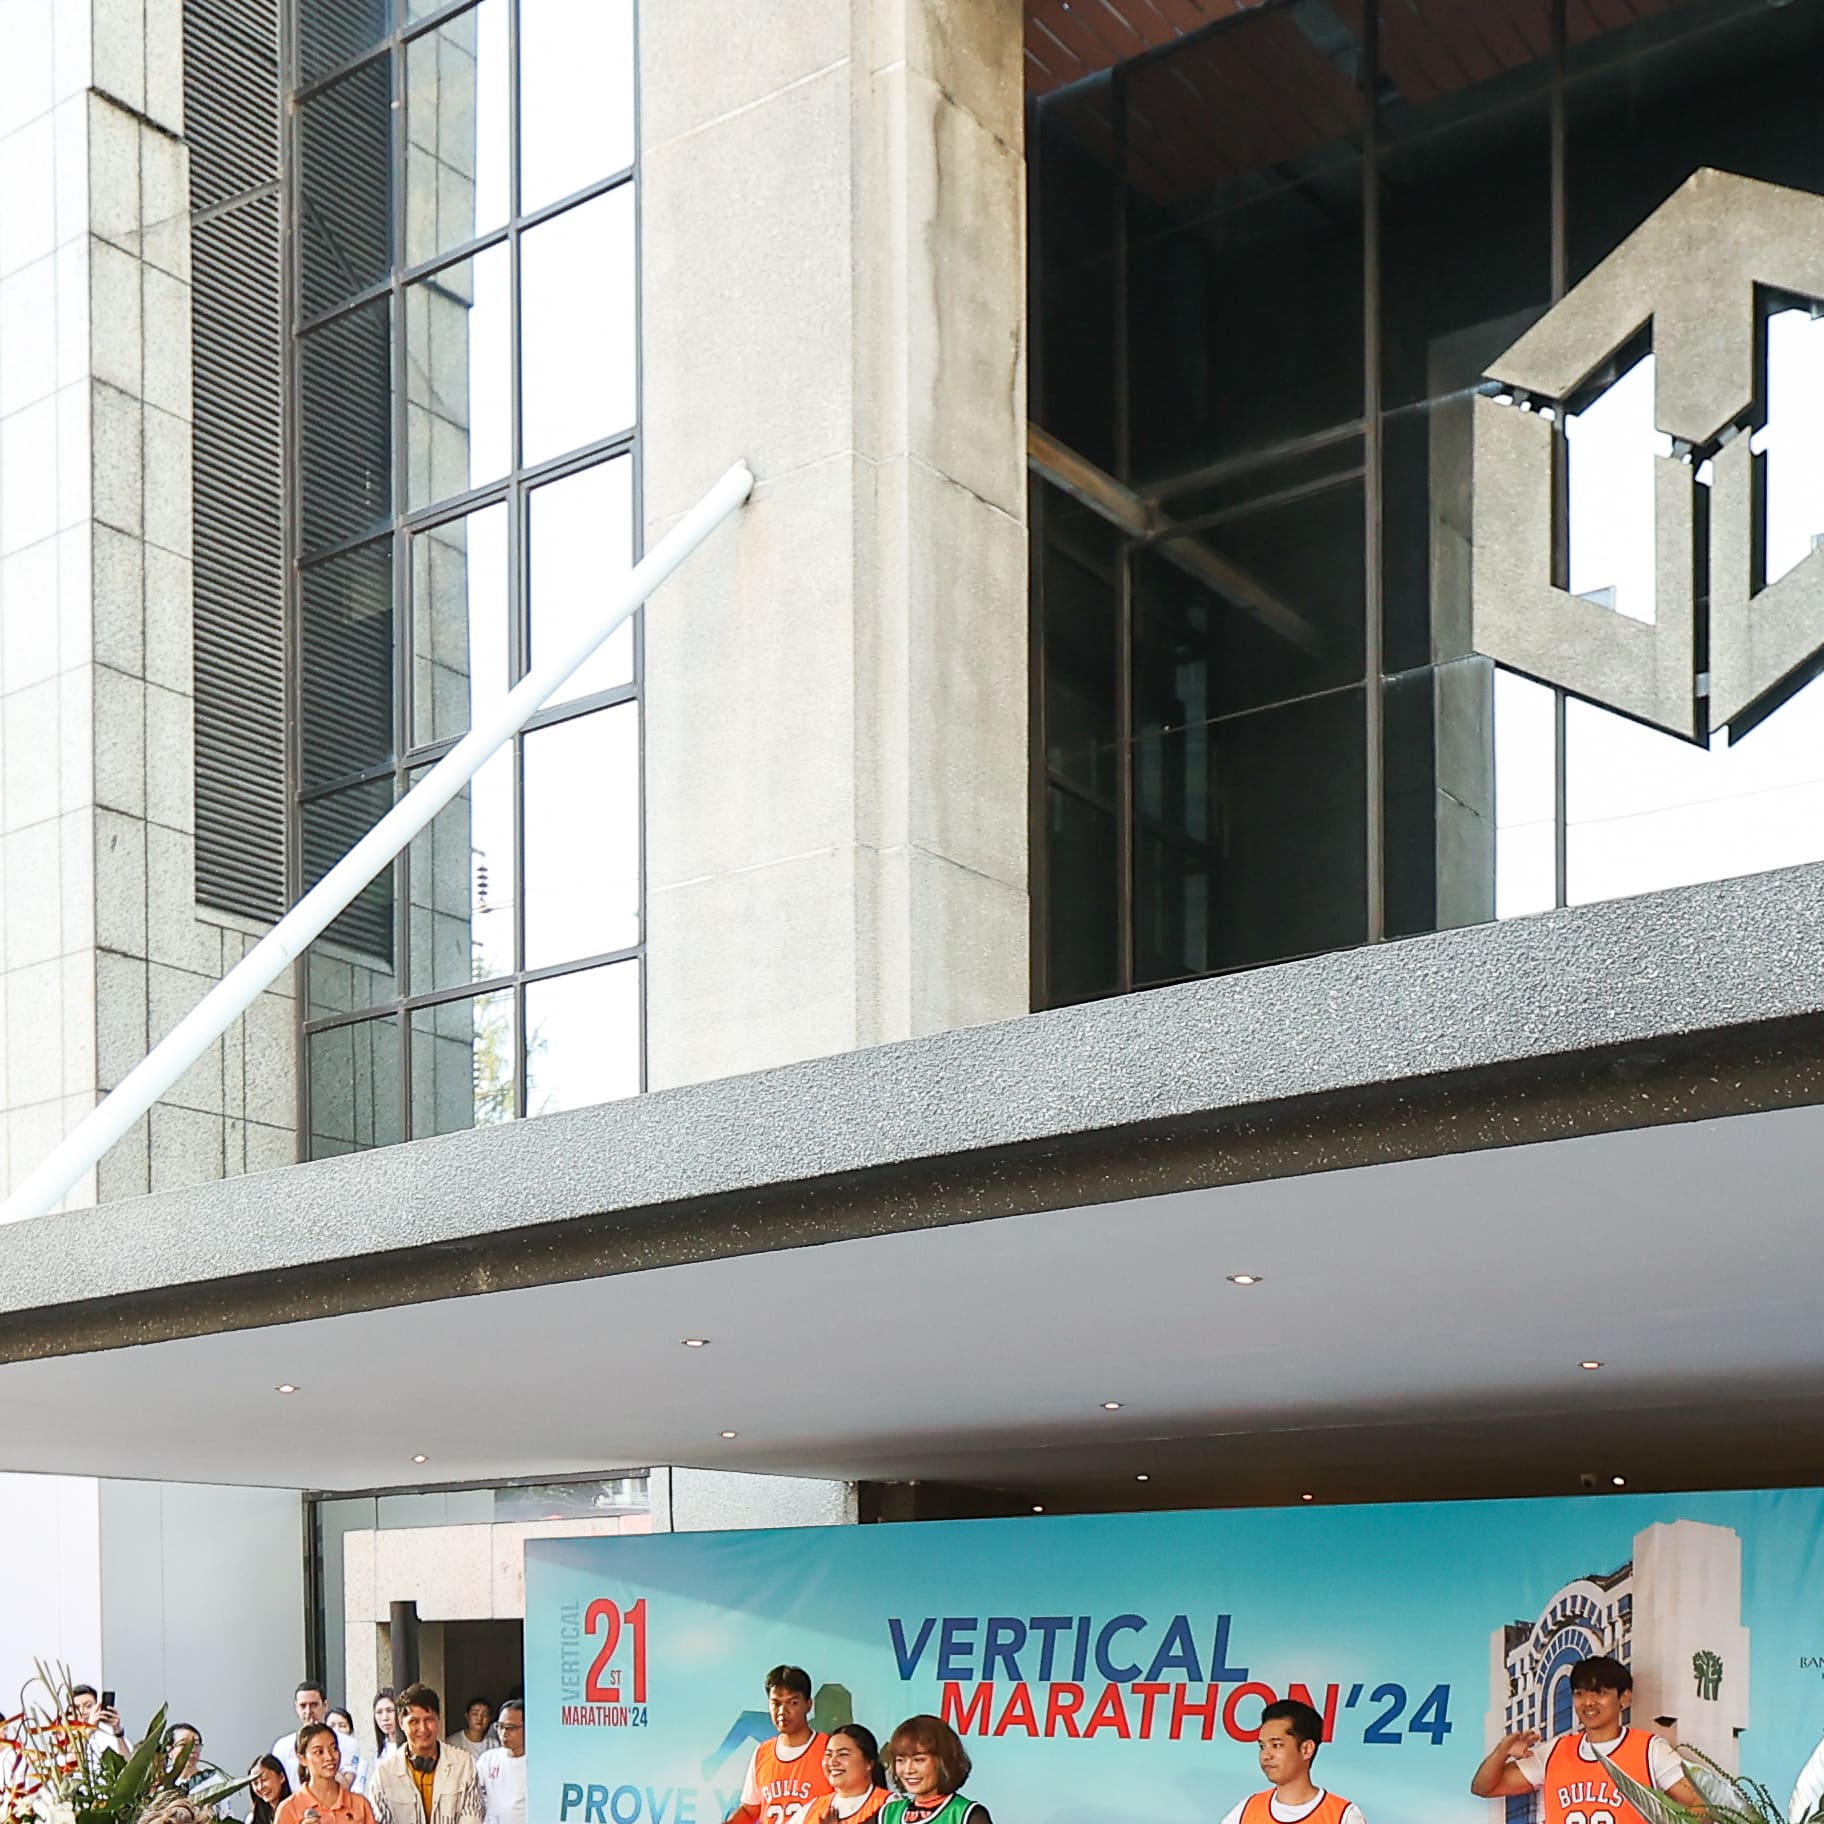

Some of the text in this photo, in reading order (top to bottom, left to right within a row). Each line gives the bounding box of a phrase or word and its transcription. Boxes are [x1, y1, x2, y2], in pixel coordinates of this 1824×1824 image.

[560, 1601, 580, 1701] VERTICAL
[584, 1598, 647, 1703] 21
[888, 1614, 1250, 1683] VERTICAL
[610, 1670, 622, 1685] ST
[762, 1781, 812, 1801] BULLS
[1558, 1782, 1624, 1809] BULLS
